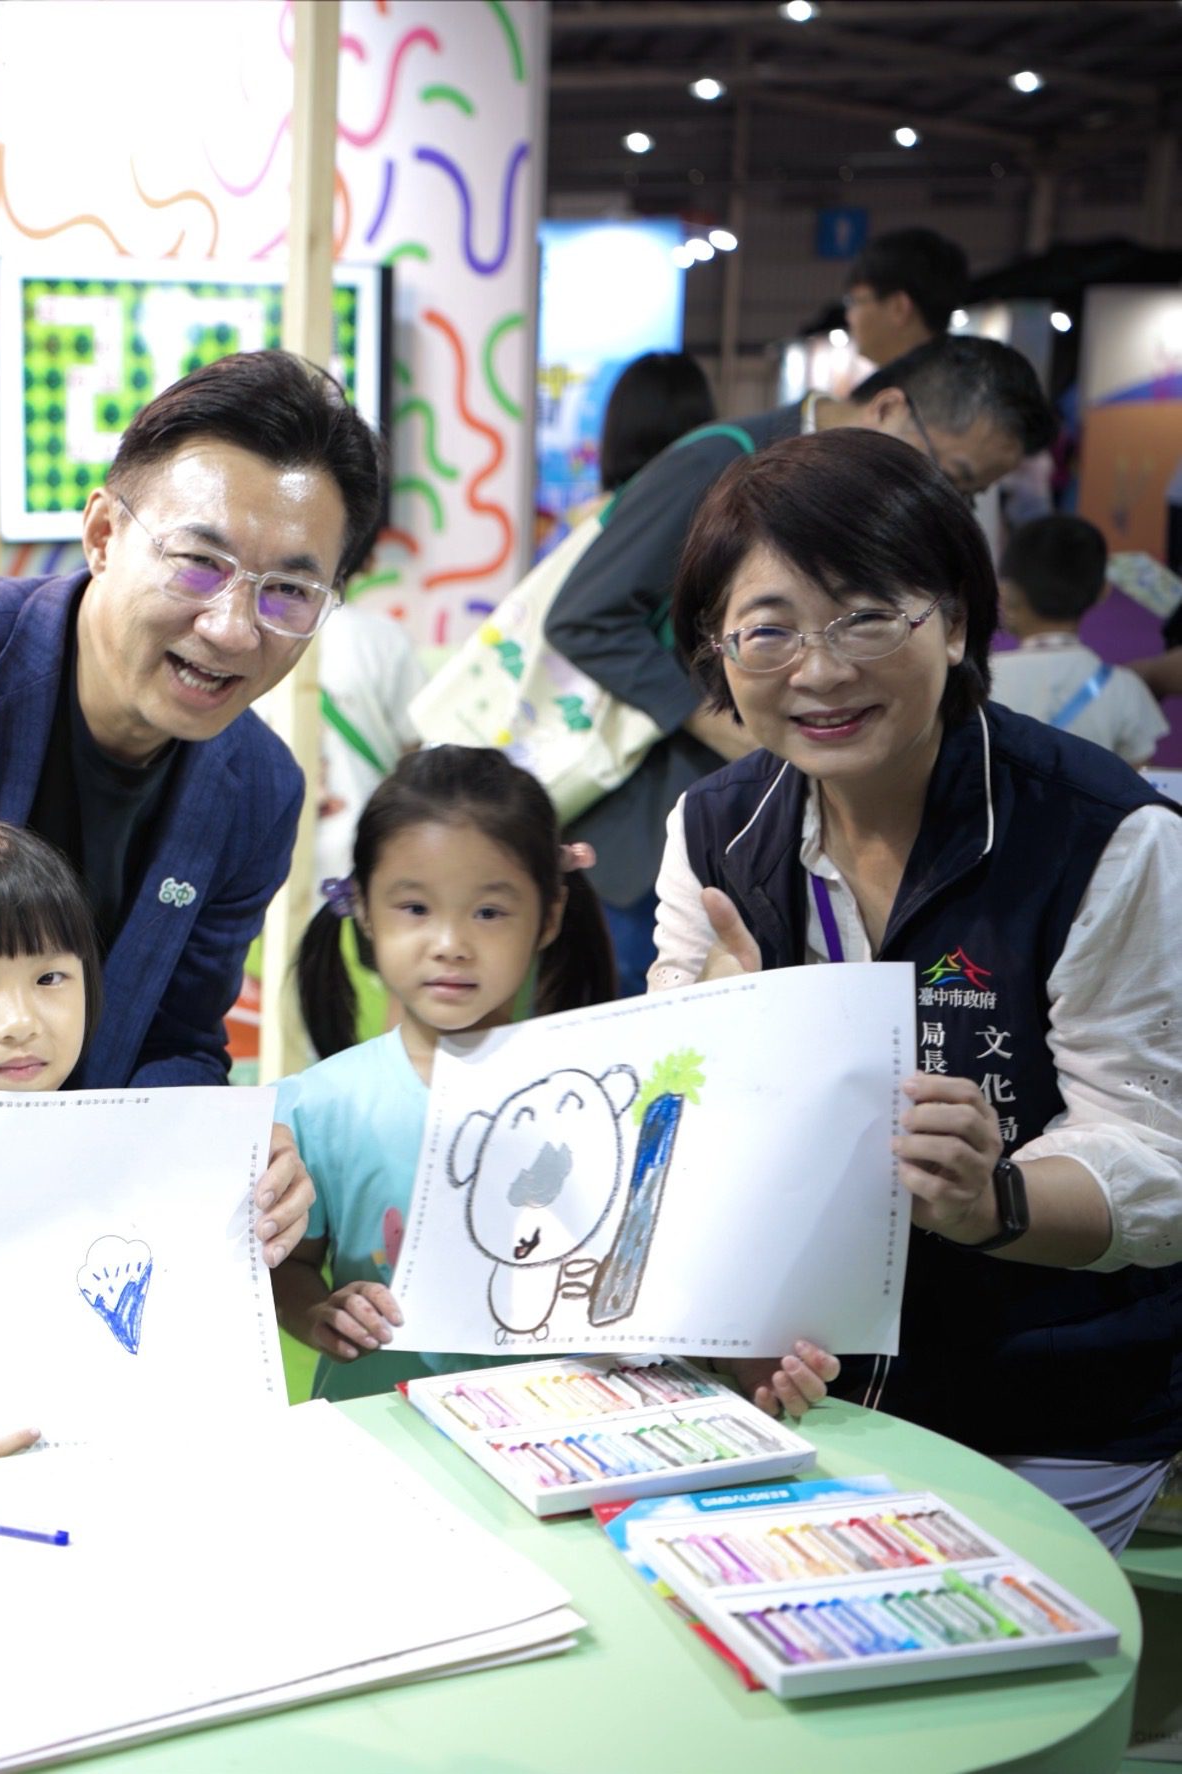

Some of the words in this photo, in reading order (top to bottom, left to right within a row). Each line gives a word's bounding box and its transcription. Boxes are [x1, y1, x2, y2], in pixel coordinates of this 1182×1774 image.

[918, 987, 997, 1010] 臺中市政府
[920, 1021, 949, 1074] 局長
